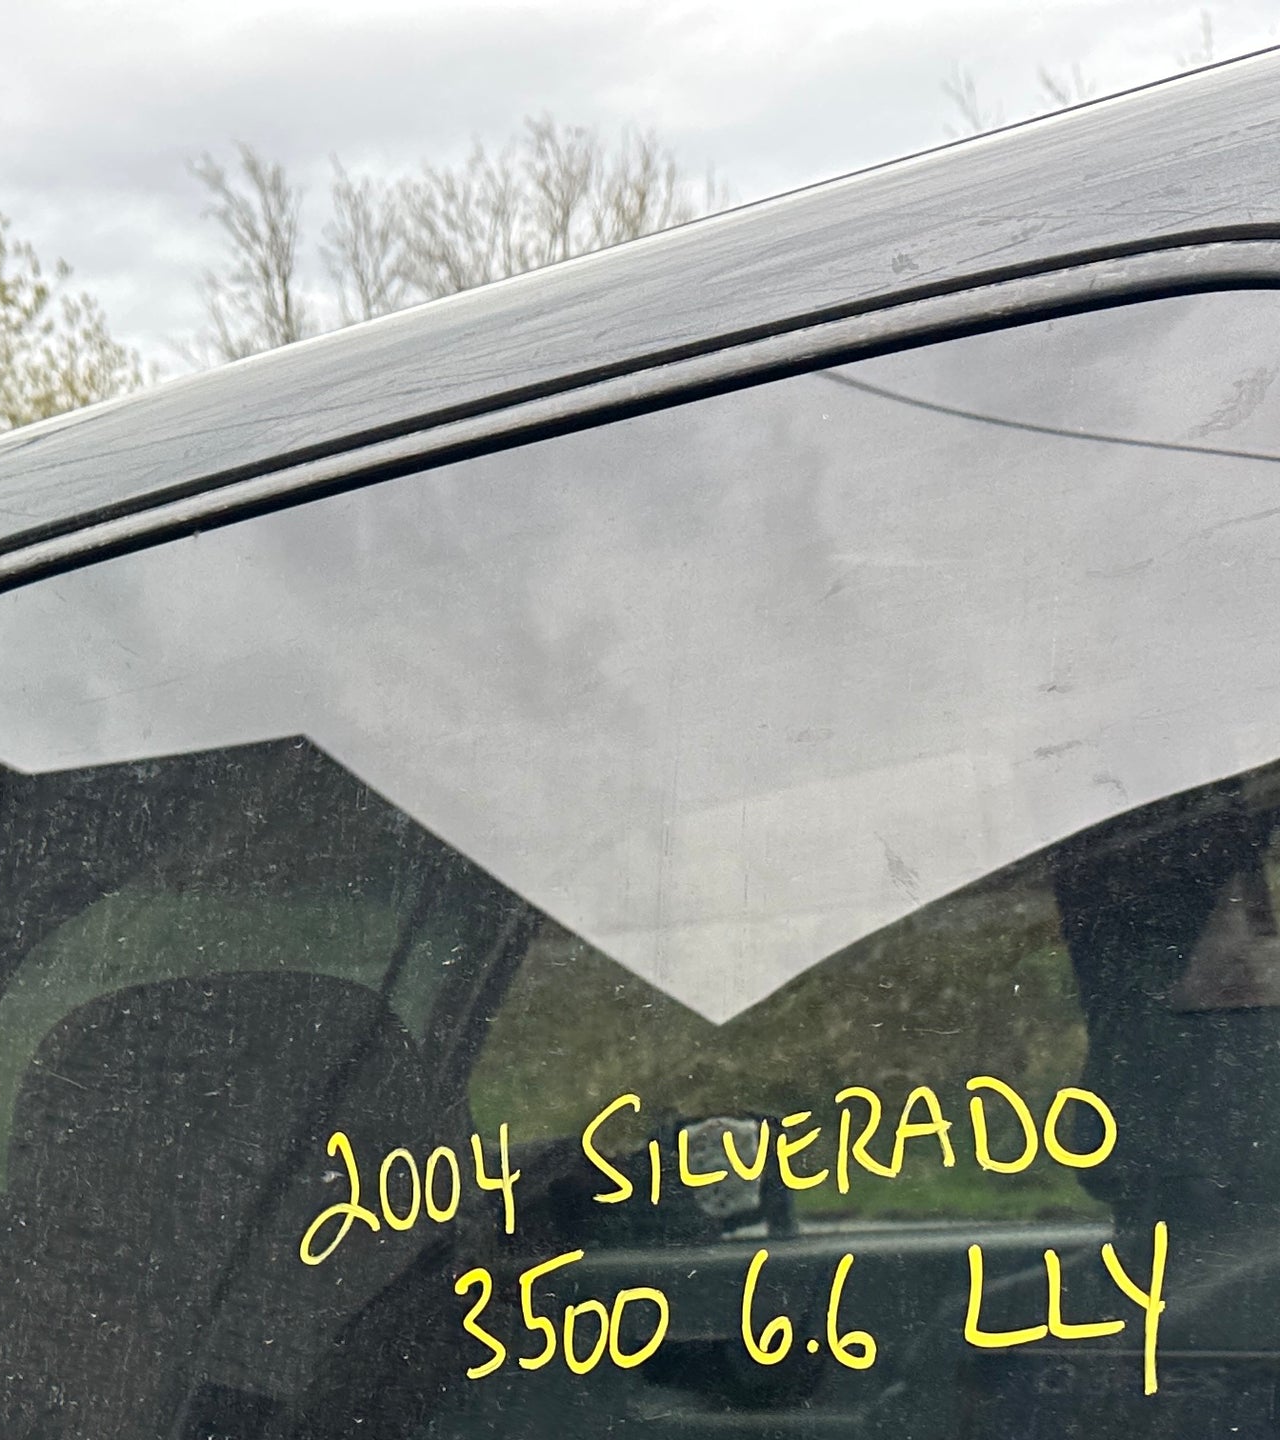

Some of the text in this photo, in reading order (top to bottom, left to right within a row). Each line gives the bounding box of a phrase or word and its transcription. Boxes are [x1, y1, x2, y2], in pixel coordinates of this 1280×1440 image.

[299, 1076, 1117, 1266] 2004 SILVERADO
[454, 1222, 1168, 1396] 3500 6.6 LLY
